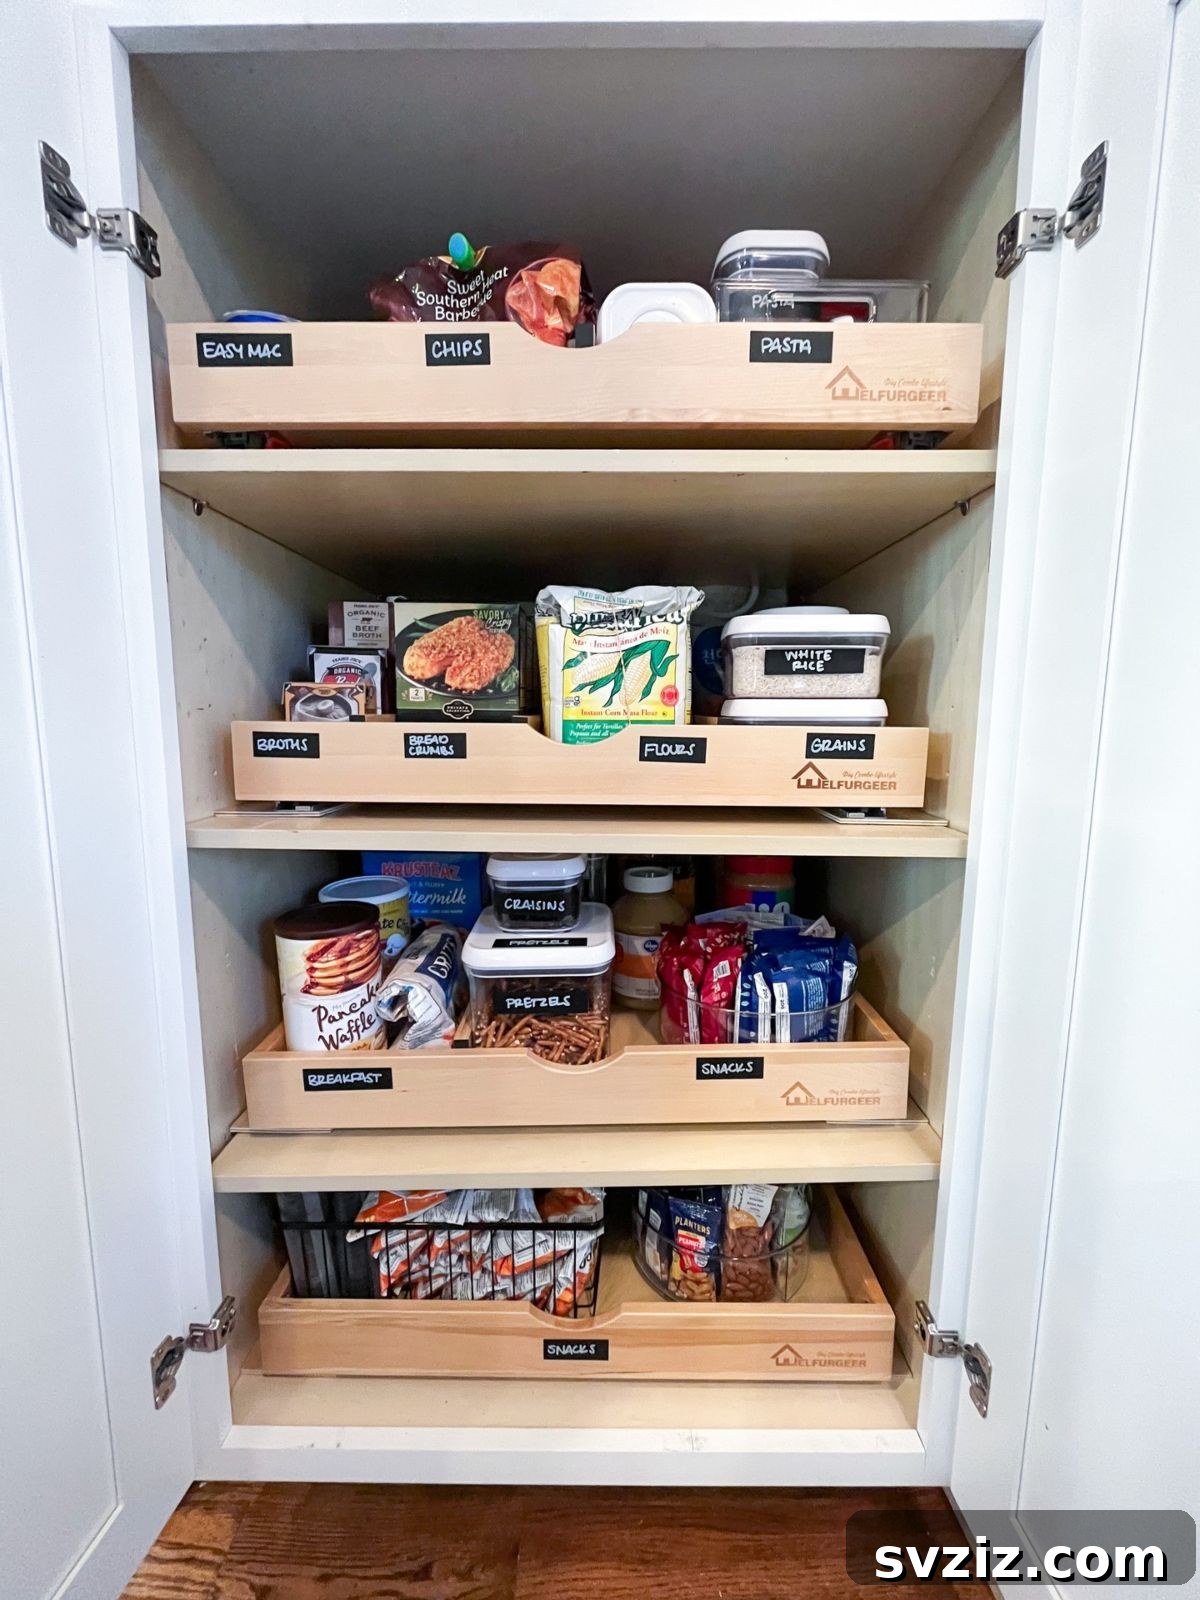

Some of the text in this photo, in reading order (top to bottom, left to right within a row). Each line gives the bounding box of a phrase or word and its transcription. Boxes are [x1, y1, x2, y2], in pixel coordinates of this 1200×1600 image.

[416, 266, 509, 309] Southern Heat
[447, 269, 485, 296] Sweet
[202, 342, 282, 359] EASY MAC
[431, 338, 483, 359] CHIPS
[761, 337, 812, 354] PASTA
[347, 609, 386, 618] ORGANIC
[473, 609, 505, 621] SAVORY
[485, 617, 512, 631] Crispy
[784, 649, 833, 662] WHITE
[333, 667, 363, 675] ORGANIC
[791, 660, 825, 672] RICE
[580, 709, 603, 717] Instant
[604, 709, 620, 717] Corn
[256, 738, 308, 752] BROTHS
[408, 735, 450, 745] BREAD
[810, 738, 866, 753] GRAINS
[408, 744, 455, 756] CRUMBS
[643, 743, 696, 757] FLOURS
[504, 898, 566, 912] CRAISINS
[505, 995, 571, 1009] PRETZELS
[701, 1061, 754, 1075] SNACKS
[307, 1071, 383, 1087] BREAKFAST
[674, 1215, 711, 1235] PLANTERS
[547, 1343, 597, 1356] SNACKS
